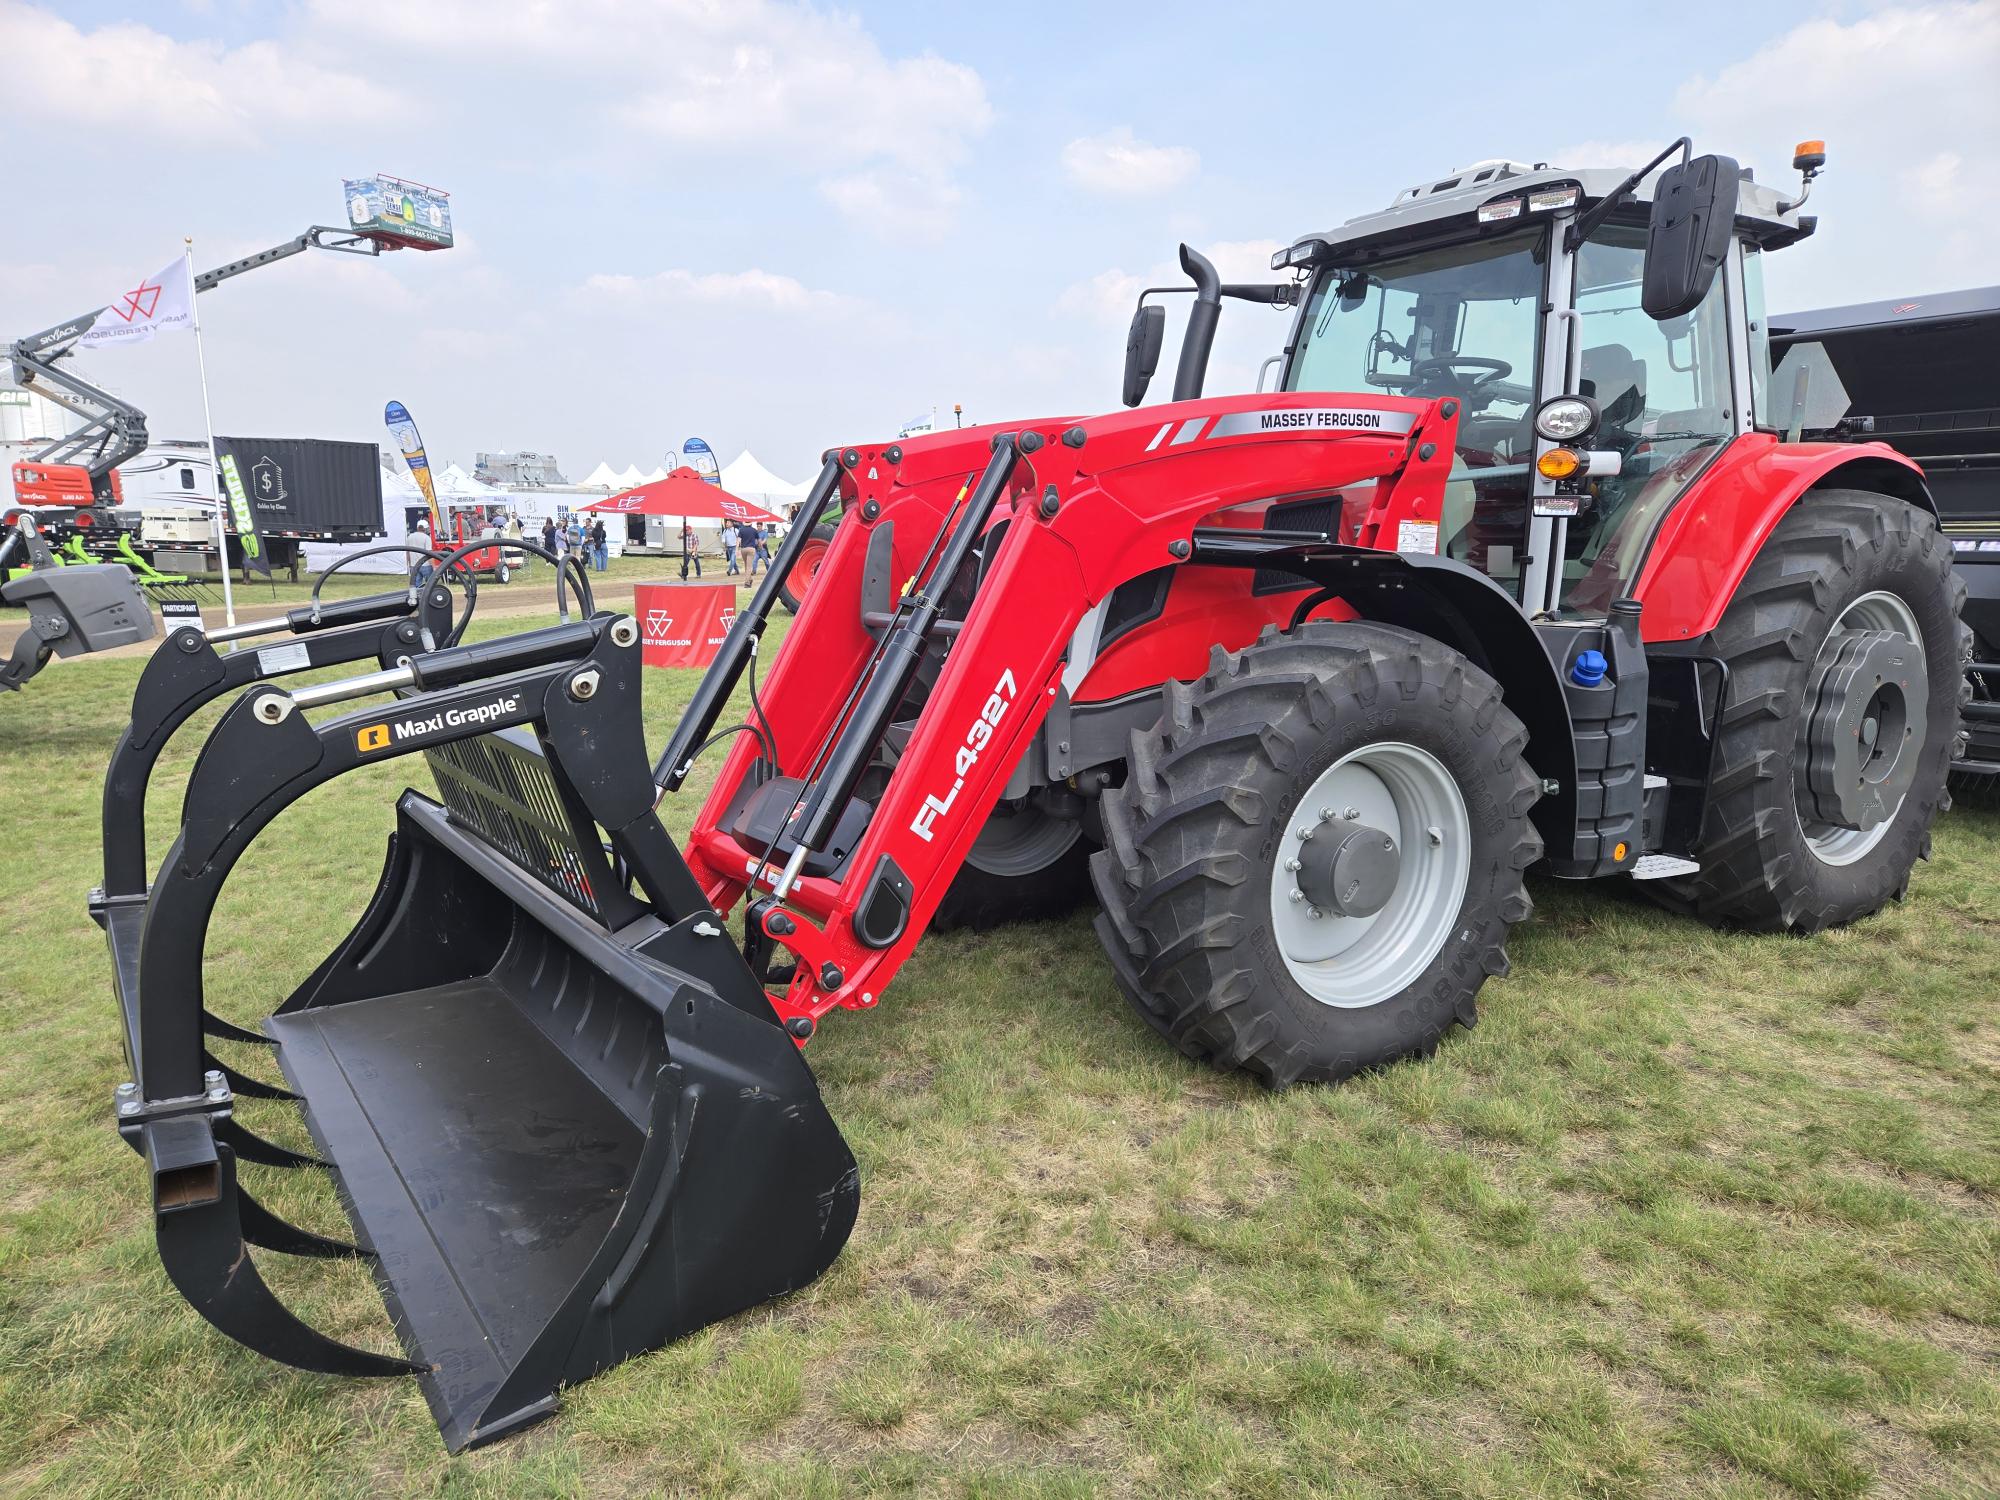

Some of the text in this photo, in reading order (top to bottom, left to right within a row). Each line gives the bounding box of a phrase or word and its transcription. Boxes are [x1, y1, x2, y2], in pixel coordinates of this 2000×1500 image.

[40, 325, 78, 345] SKYJACK
[1261, 413, 1380, 428] MASSEY FERGUSON
[557, 505, 569, 513] BIN
[394, 713, 444, 739] Maxi
[1365, 708, 1399, 733] 30
